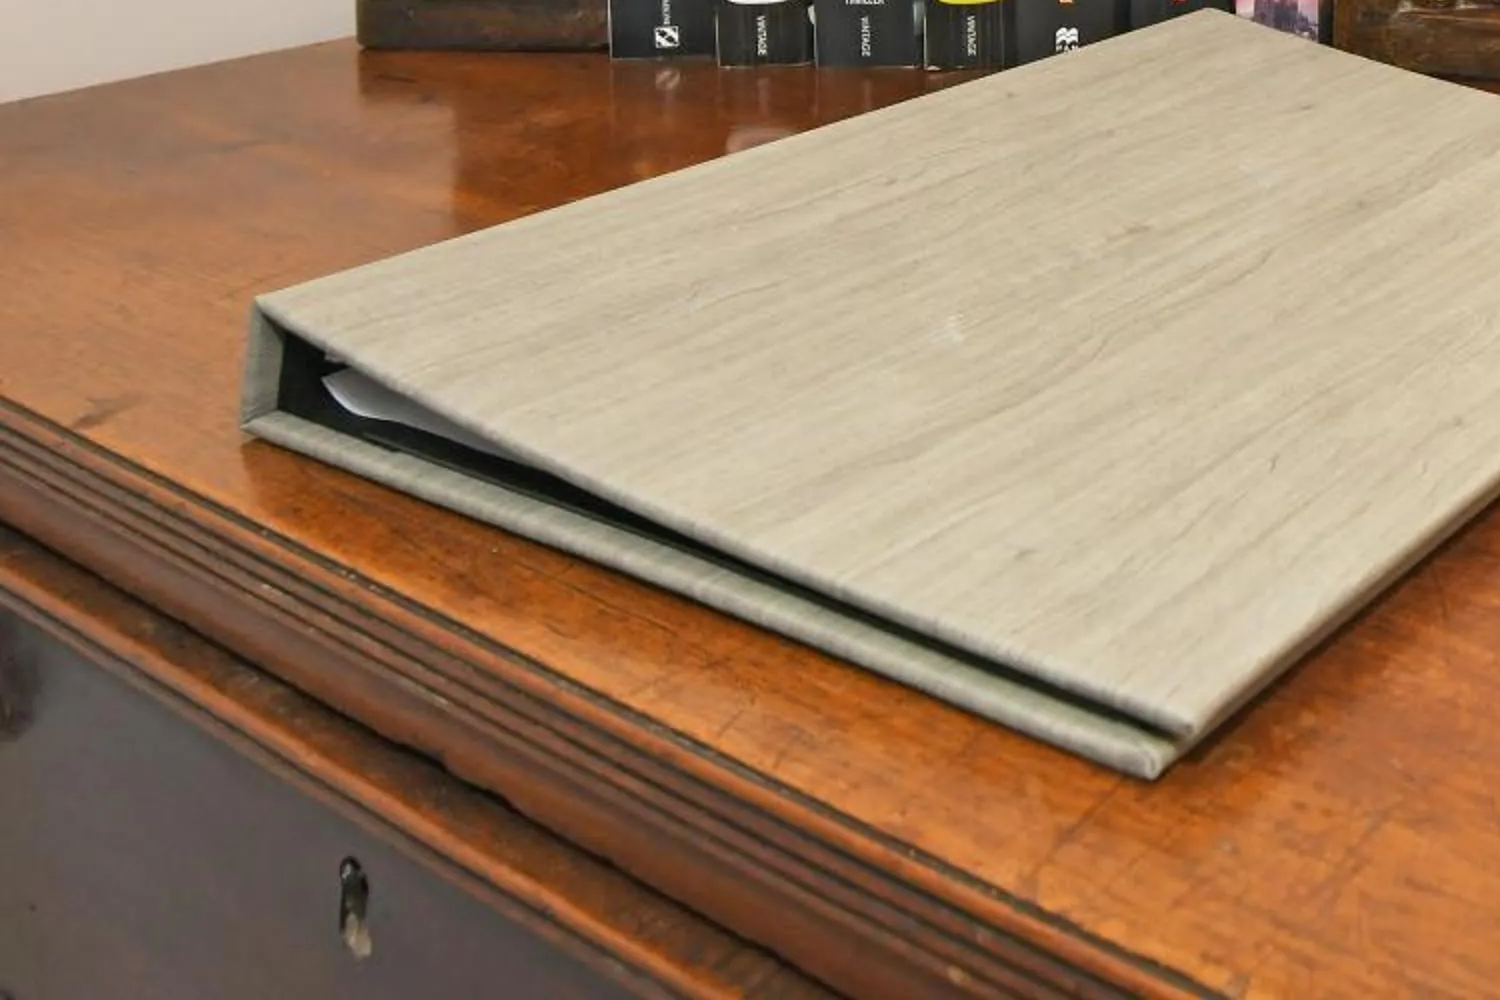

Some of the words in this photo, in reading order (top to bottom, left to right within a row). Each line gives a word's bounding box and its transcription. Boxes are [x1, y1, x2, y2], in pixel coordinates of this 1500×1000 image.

[756, 15, 768, 56] VINTAGE
[860, 15, 871, 57] VINTAGE
[967, 15, 977, 57] VINTAGE
